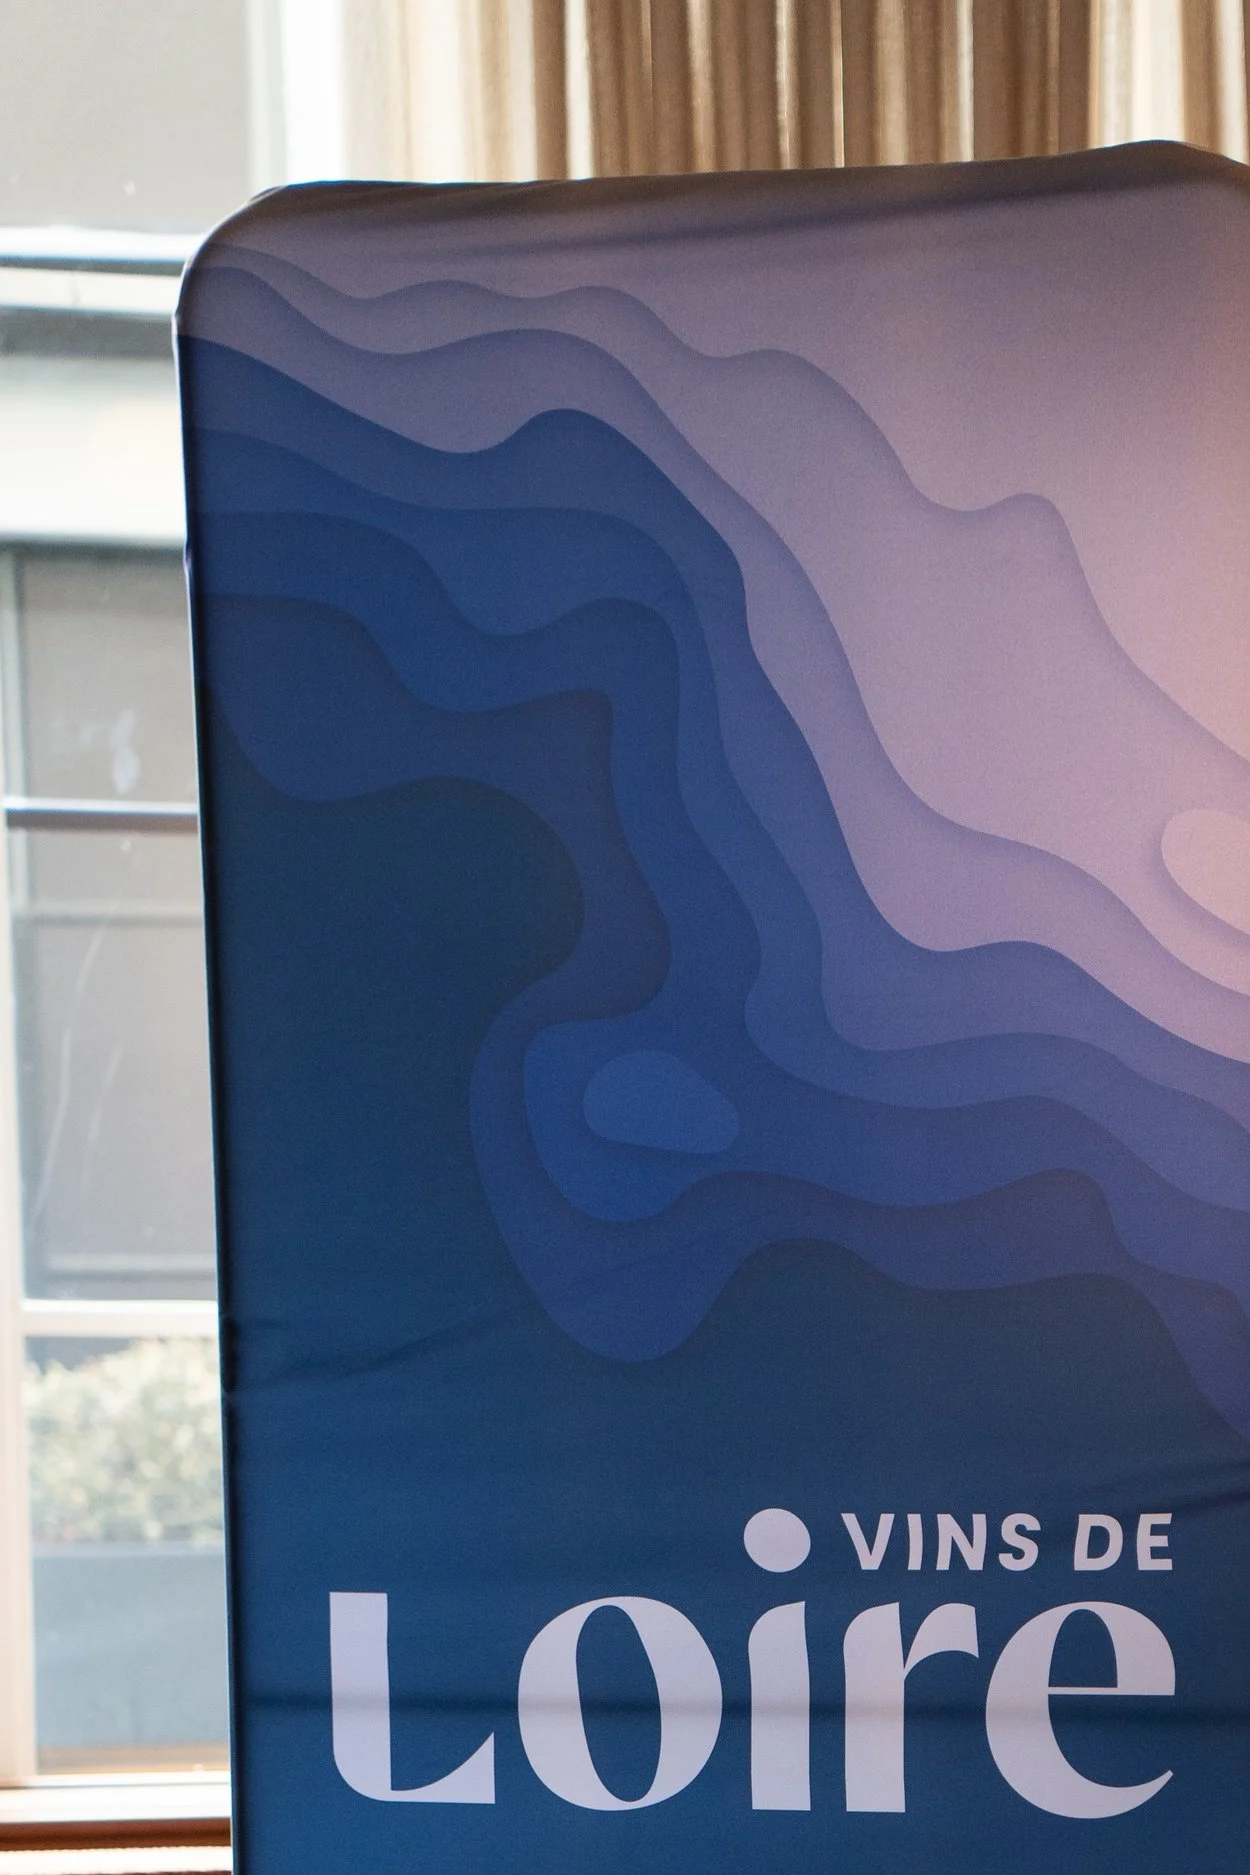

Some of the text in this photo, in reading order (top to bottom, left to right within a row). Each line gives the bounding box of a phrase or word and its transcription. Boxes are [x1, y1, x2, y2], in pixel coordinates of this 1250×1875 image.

[840, 1512, 1173, 1571] VINS DE
[329, 1508, 1176, 1819] Loire
